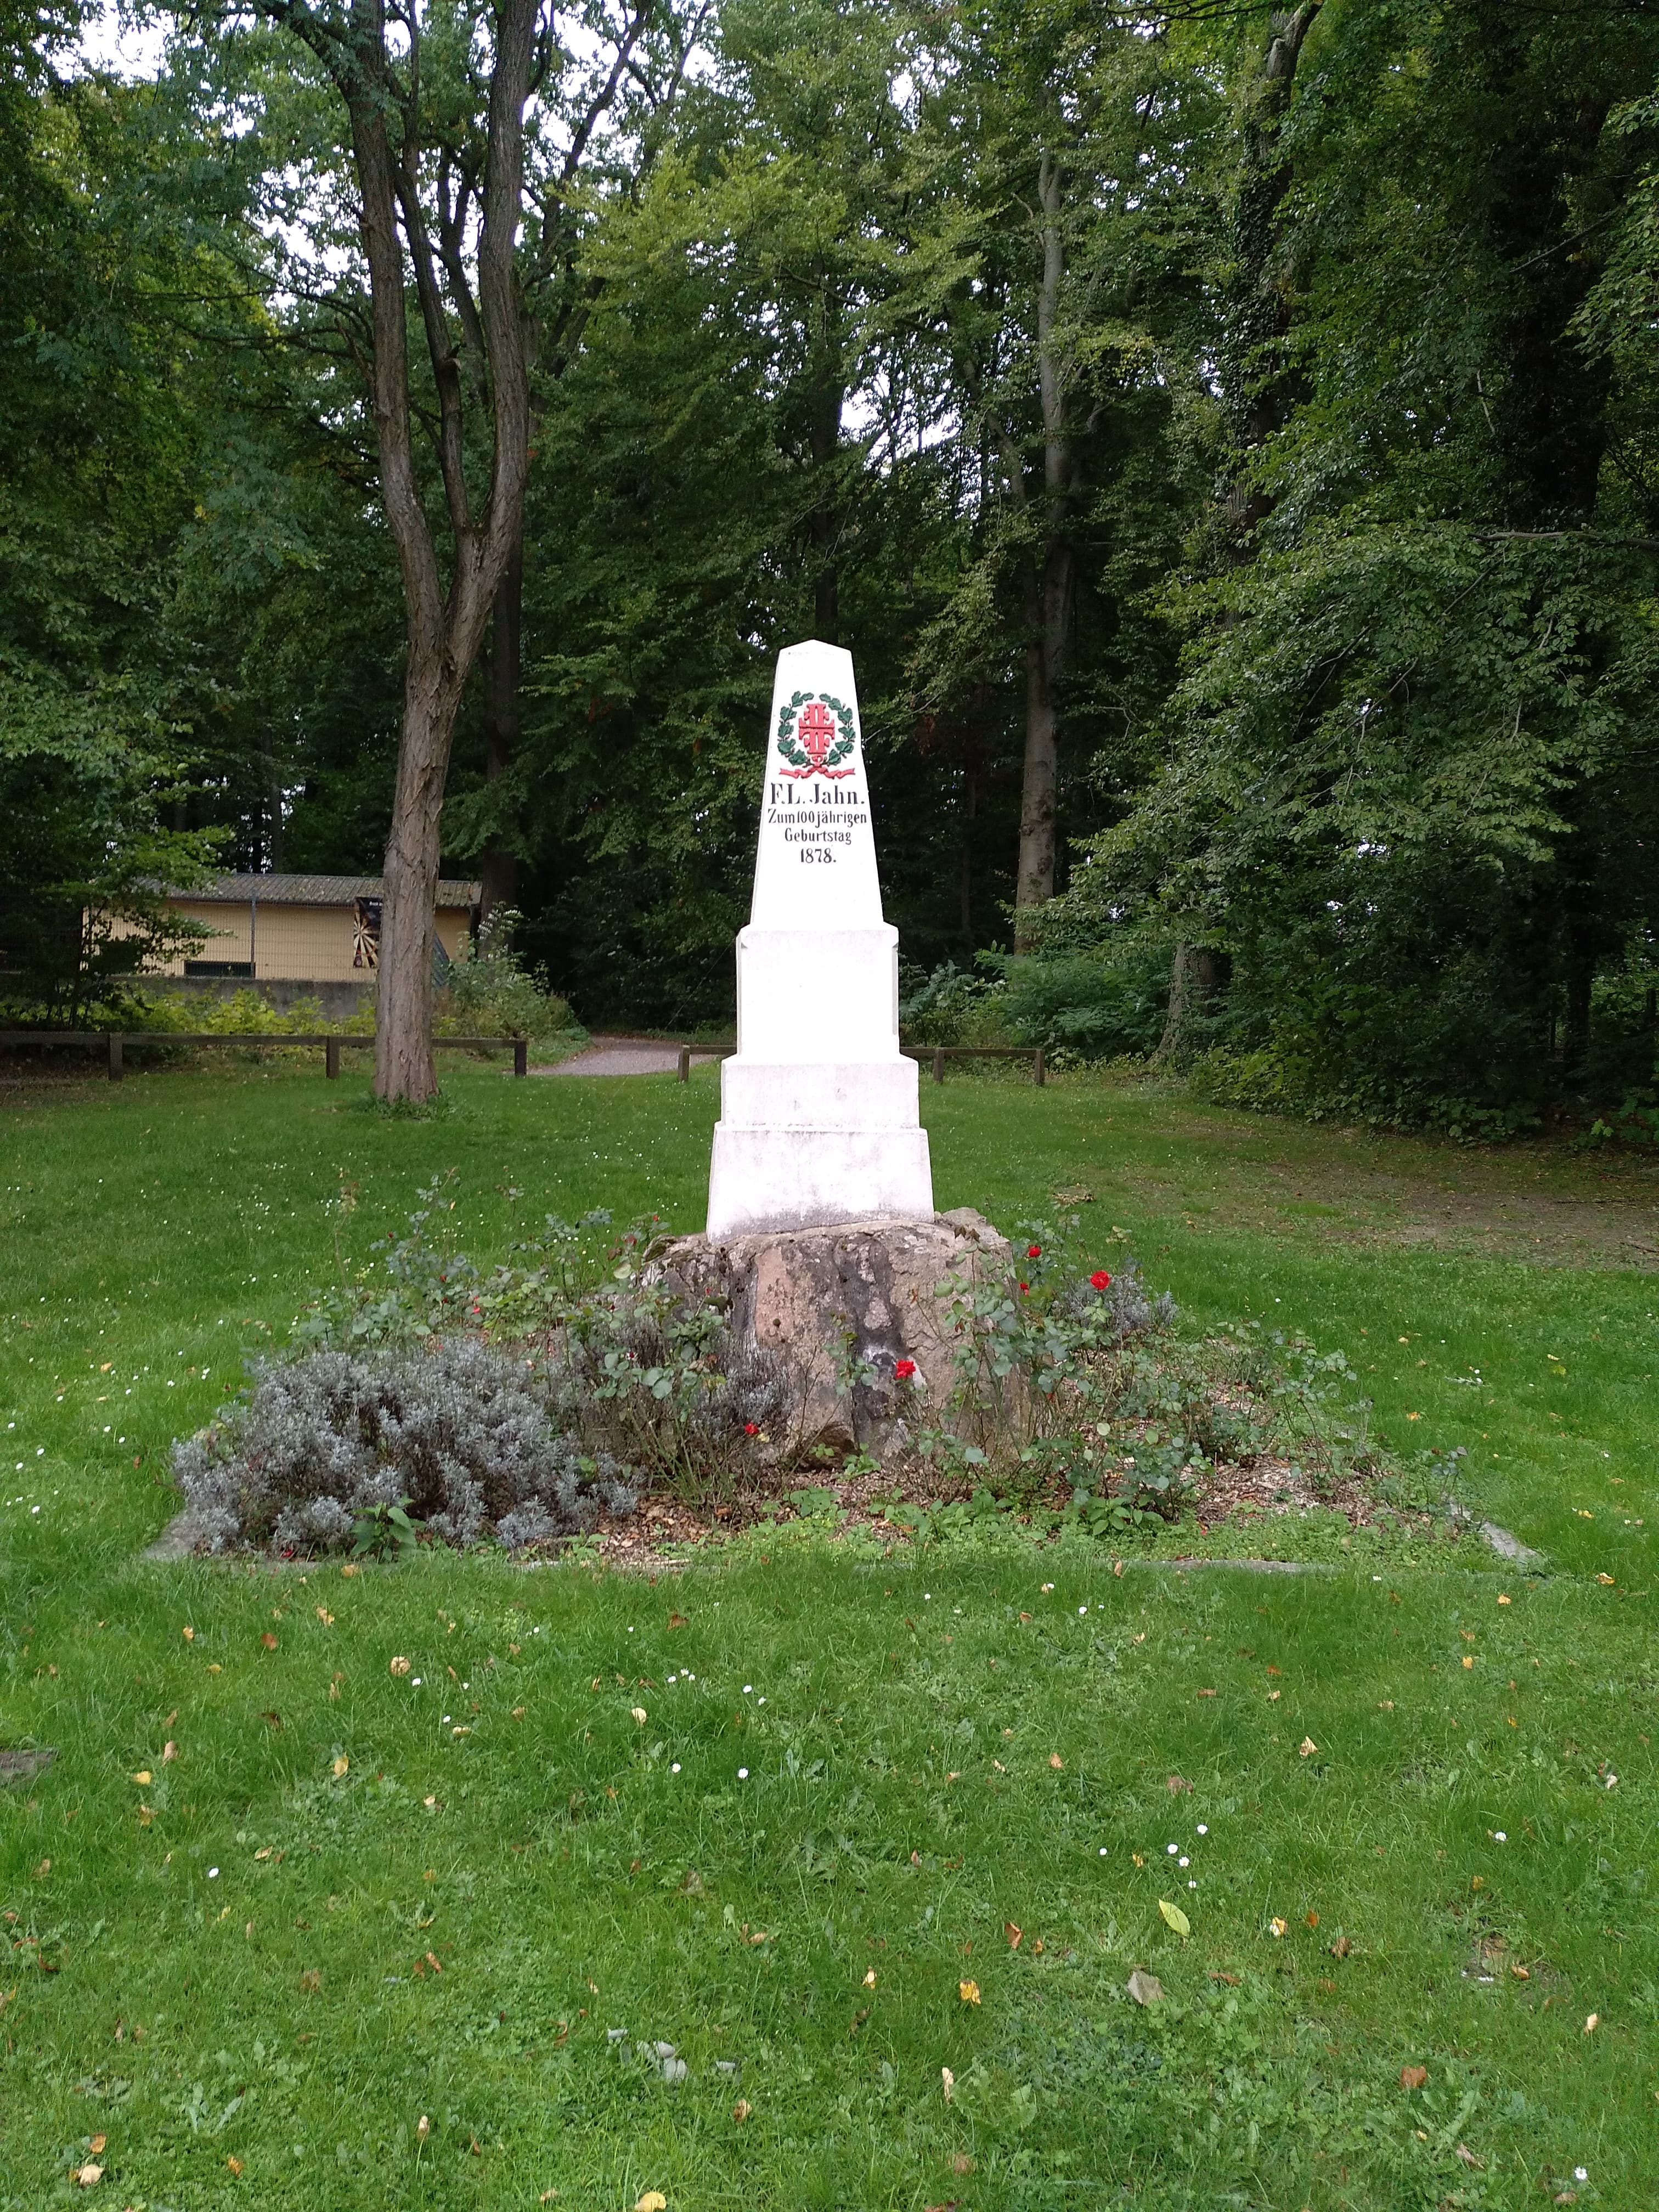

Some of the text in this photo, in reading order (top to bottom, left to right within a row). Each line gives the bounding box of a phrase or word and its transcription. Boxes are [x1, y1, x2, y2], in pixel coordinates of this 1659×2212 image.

[809, 783, 865, 804] Jahn.
[768, 809, 795, 823] Zum
[785, 827, 851, 845] Geburtstag
[800, 848, 837, 864] 1878.
